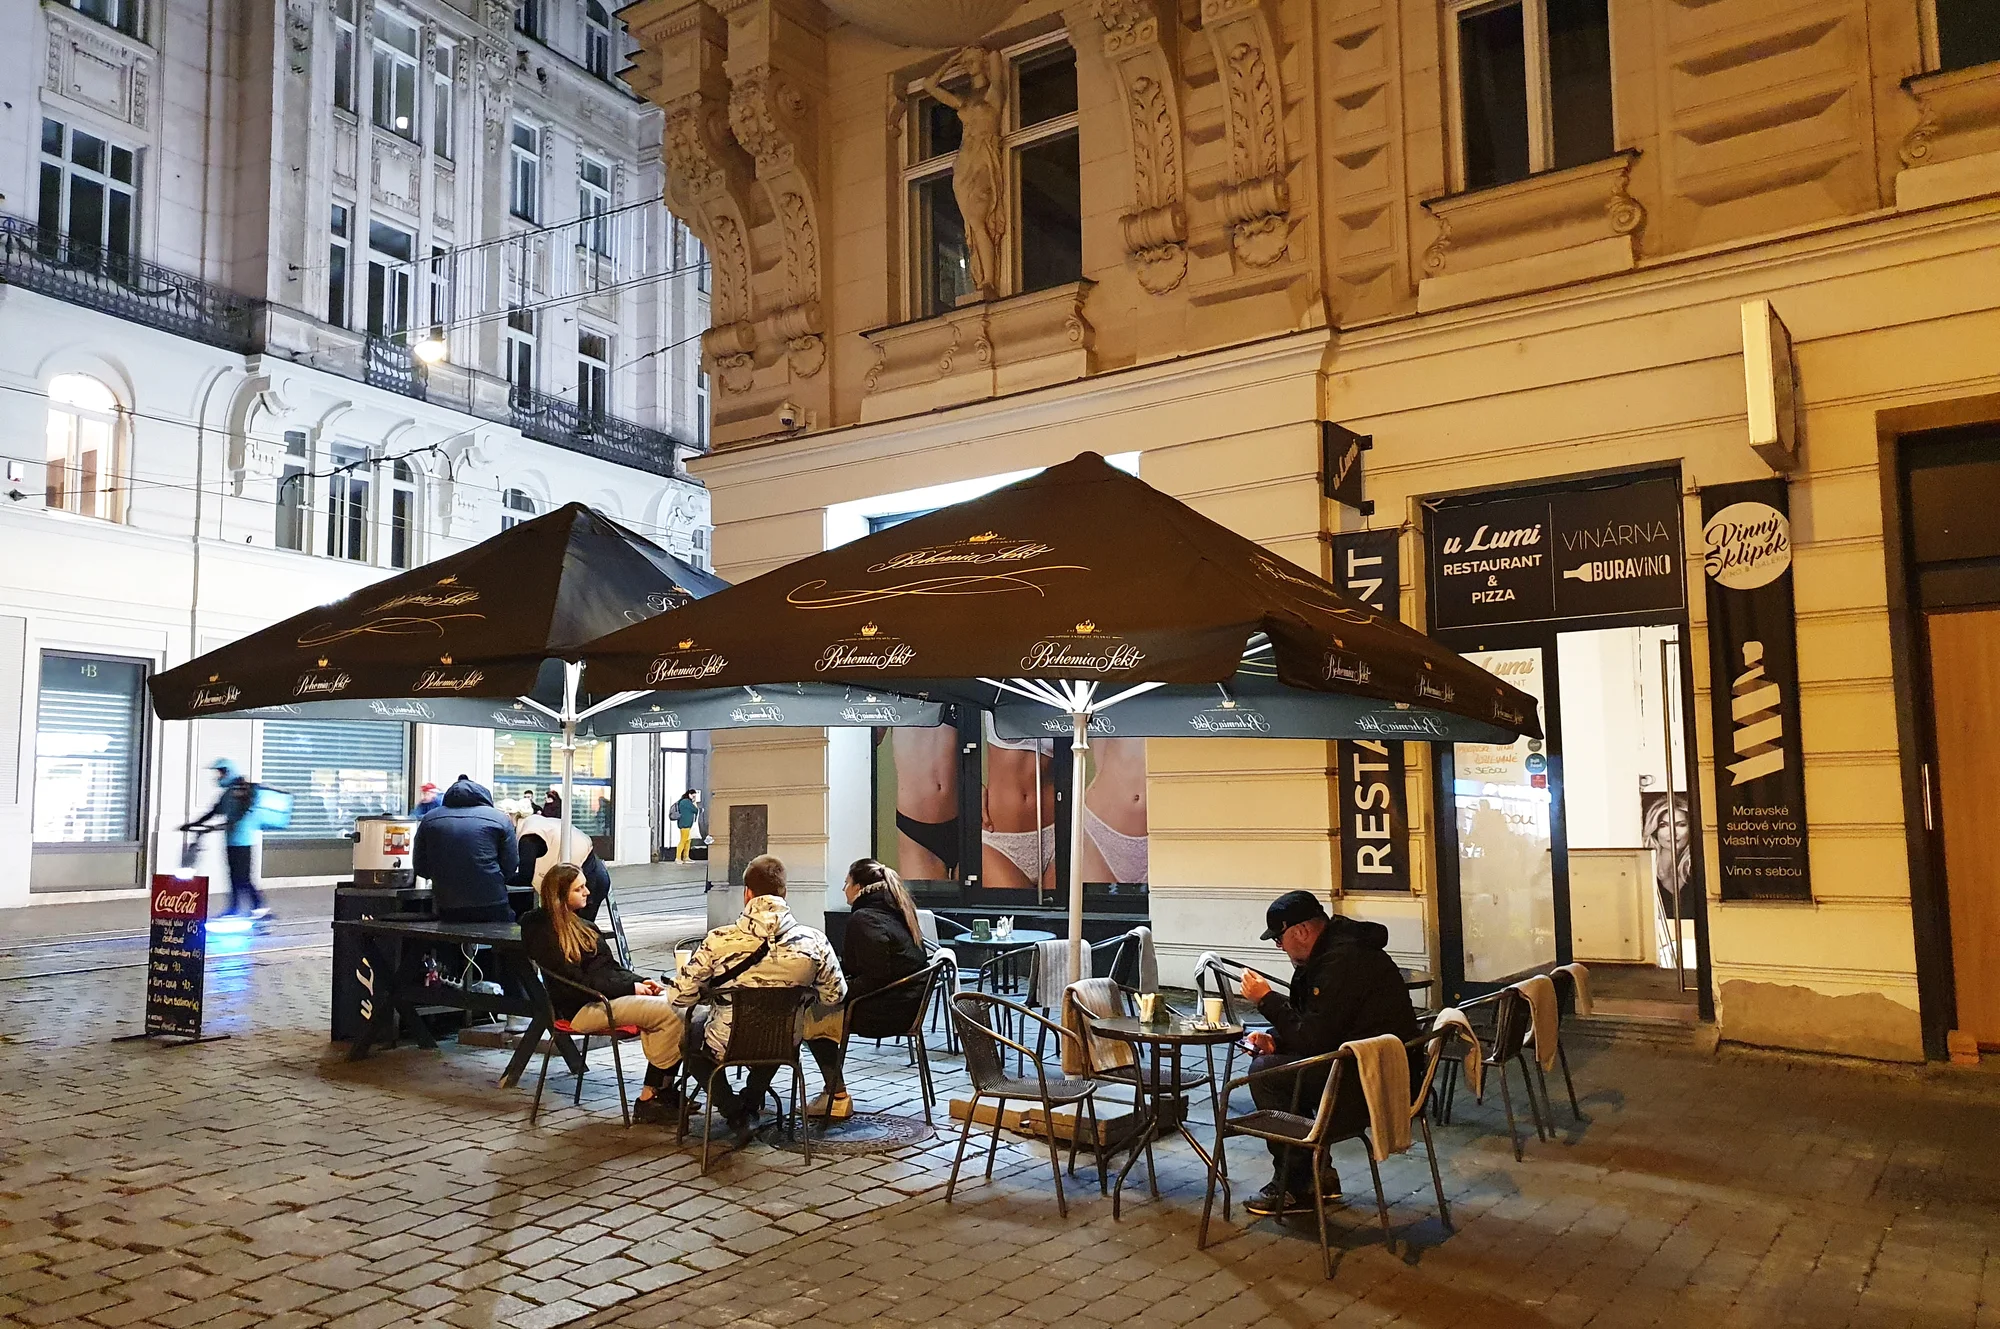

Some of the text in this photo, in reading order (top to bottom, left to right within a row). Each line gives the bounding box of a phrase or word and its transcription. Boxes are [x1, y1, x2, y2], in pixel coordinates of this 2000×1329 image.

[1443, 524, 1542, 554] u Lumi
[1562, 520, 1670, 551] VINÁRNA
[1443, 553, 1542, 576] RESTAURANT
[1487, 575, 1498, 586] &
[1472, 589, 1515, 604] PIZZA
[815, 643, 917, 672] Bohemia Sekt
[1020, 641, 1146, 672] Bohemia Sekt
[646, 654, 728, 685] Bohemia Sekt
[412, 670, 457, 691] Bohemia
[1732, 805, 1789, 816] Moravské
[1726, 819, 1797, 831] sudové víno
[1723, 834, 1802, 847] vlastní výroby
[1754, 867, 1762, 876] s
[1765, 866, 1802, 877] sebou
